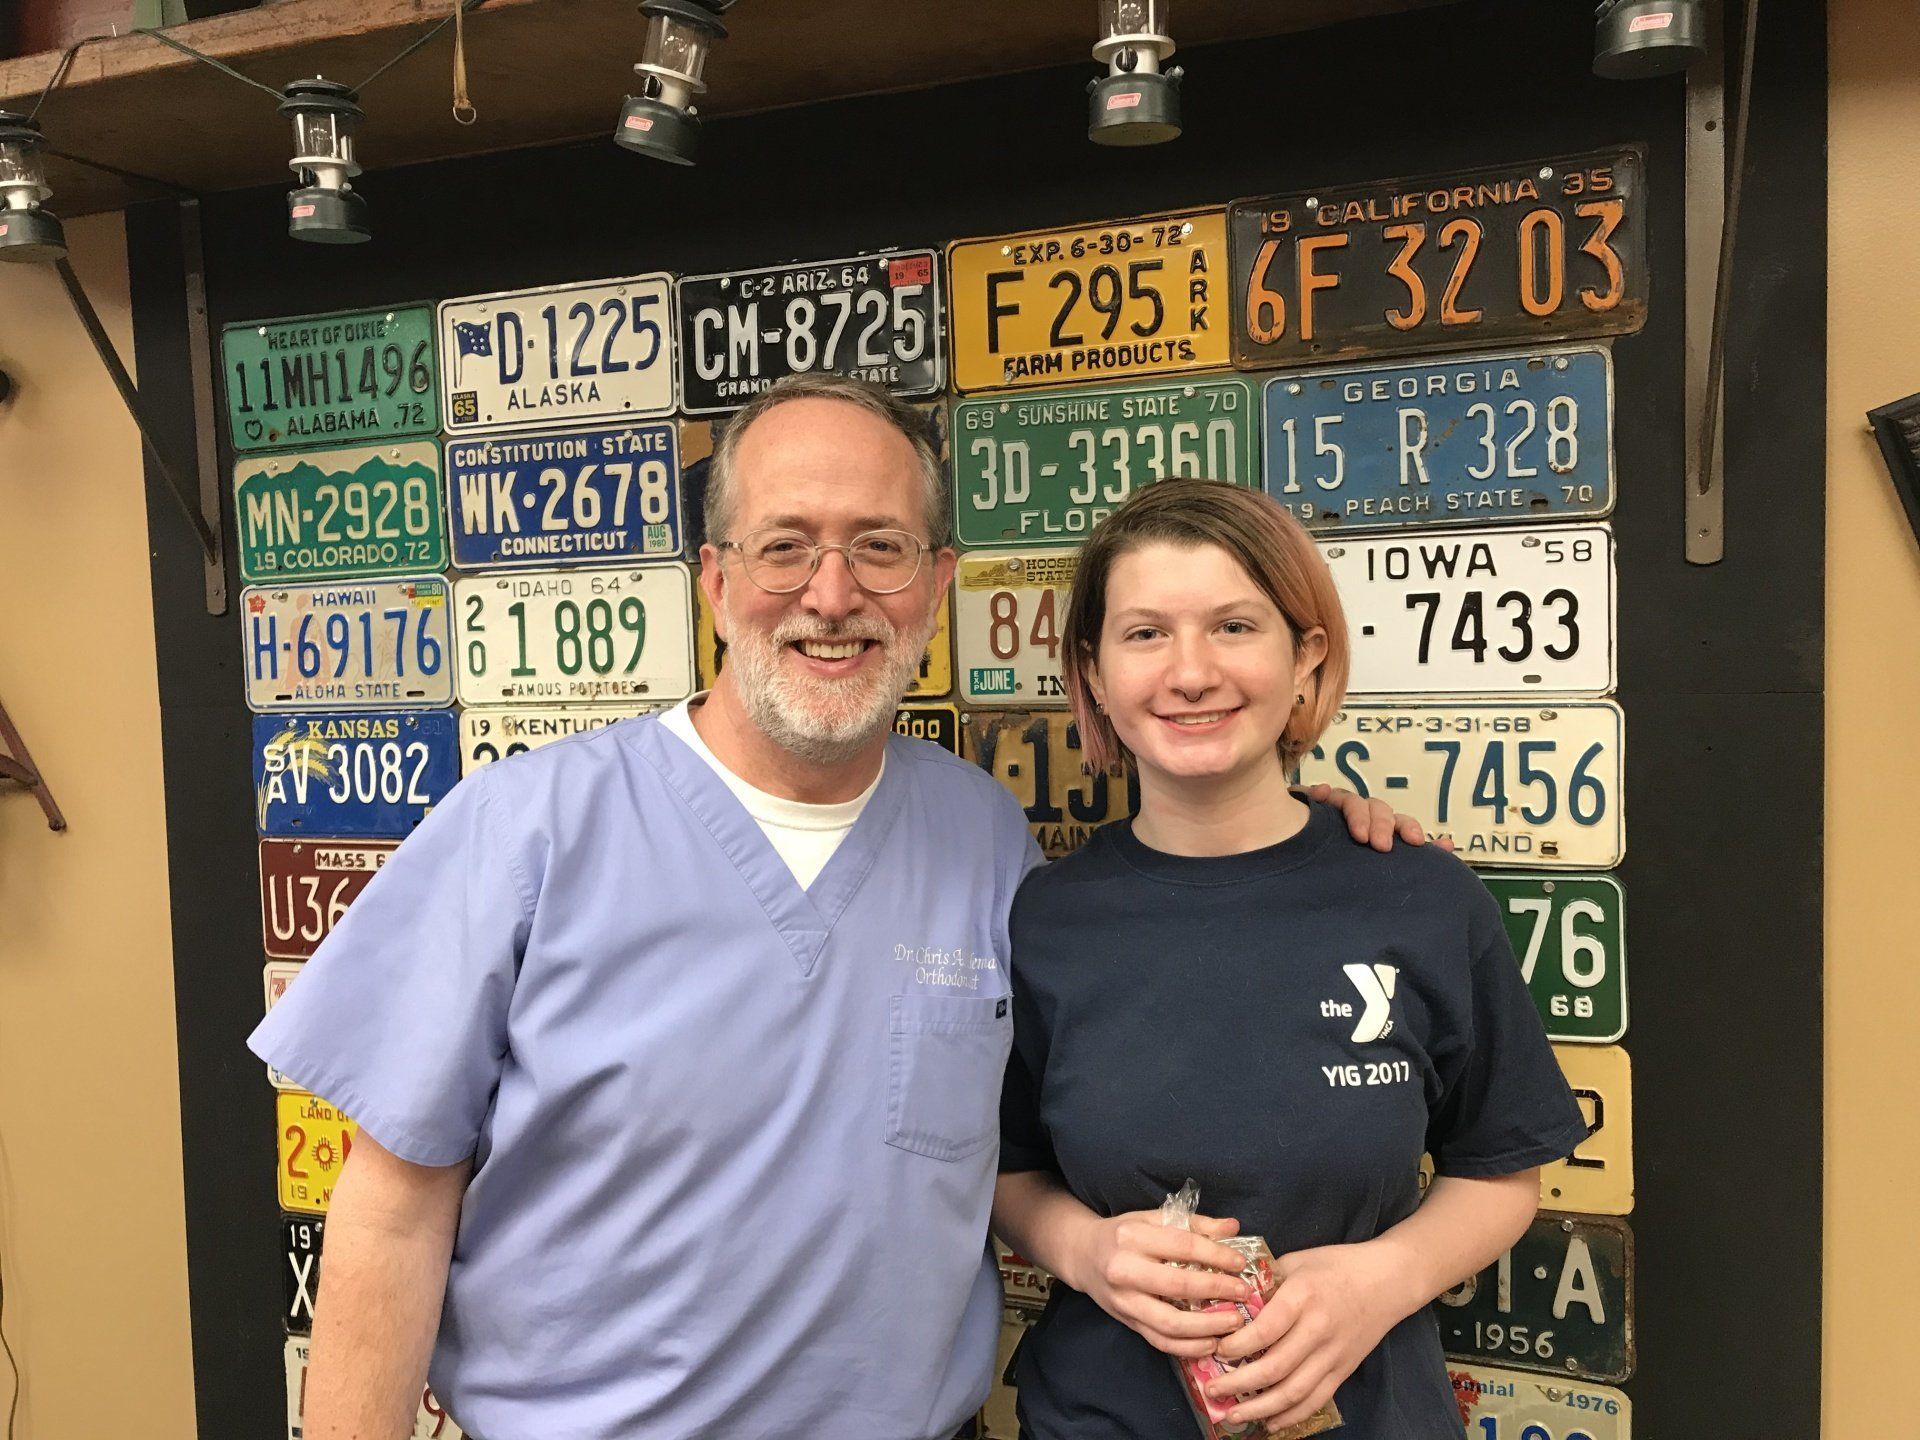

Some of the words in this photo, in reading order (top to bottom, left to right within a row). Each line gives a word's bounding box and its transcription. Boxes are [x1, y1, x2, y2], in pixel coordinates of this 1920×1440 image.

[1261, 209, 1290, 232] 19
[1316, 179, 1538, 226] CALIFORNIA
[1563, 169, 1613, 194] 35
[841, 265, 870, 286] 64
[986, 270, 1024, 353] F
[1049, 259, 1164, 347] 295
[268, 328, 319, 350] HEART
[344, 320, 386, 342] DIXIE
[694, 283, 925, 381] CM-8725
[1003, 352, 1062, 377] FARM
[1071, 340, 1193, 371] PRODUCTS
[236, 340, 431, 413] 11MH1496
[716, 378, 771, 397] GRAND
[1343, 368, 1522, 404] GEORGIA
[454, 400, 476, 416] 65
[507, 381, 601, 411] ALASKA
[287, 408, 380, 436] ALABAMA
[966, 409, 995, 430] 69
[1018, 400, 1110, 427] SUNSHINE
[1122, 394, 1181, 419] STATE
[1205, 390, 1238, 412] 70
[454, 439, 588, 468] CONSTITUTION
[601, 431, 668, 456] STATE
[1281, 414, 1345, 494] 15
[1396, 407, 1431, 485] R
[1466, 395, 1580, 481] 328
[1345, 495, 1431, 517] PEACH
[1446, 488, 1525, 511] STATE
[1561, 484, 1594, 504] 70
[646, 523, 667, 539] AUG
[1019, 508, 1112, 534] FLOR
[254, 551, 278, 571] 19
[283, 541, 398, 569] COLORADO
[405, 541, 431, 561] 72
[500, 531, 629, 556] CONNECTICUT
[1026, 557, 1080, 569] HOOSI
[1367, 542, 1498, 582] IOWA
[1544, 539, 1593, 564] 58
[512, 579, 573, 598] IDAHO
[591, 577, 621, 594] 64
[1026, 570, 1074, 582] STATE
[312, 590, 377, 607] HAWAII
[295, 683, 346, 699] ALOHA
[355, 682, 401, 698] STATE
[510, 683, 562, 697] FAMOUS
[569, 680, 640, 696] POTATOES
[980, 669, 1012, 691] JUNE
[307, 719, 400, 740] KANSAS
[471, 719, 490, 737] 19
[1309, 740, 1607, 826] S-7456
[317, 852, 366, 868] MASS
[916, 946, 950, 965] Chris
[1508, 897, 1606, 989] 76
[1320, 999, 1353, 1018] the
[1550, 994, 1594, 1018] 68
[1321, 1064, 1362, 1087] YIG
[300, 1106, 332, 1121] LAND
[291, 1183, 308, 1200] 19
[290, 1223, 311, 1250] 19
[1475, 1321, 1554, 1359] 1956
[1566, 1391, 1619, 1416] 1976
